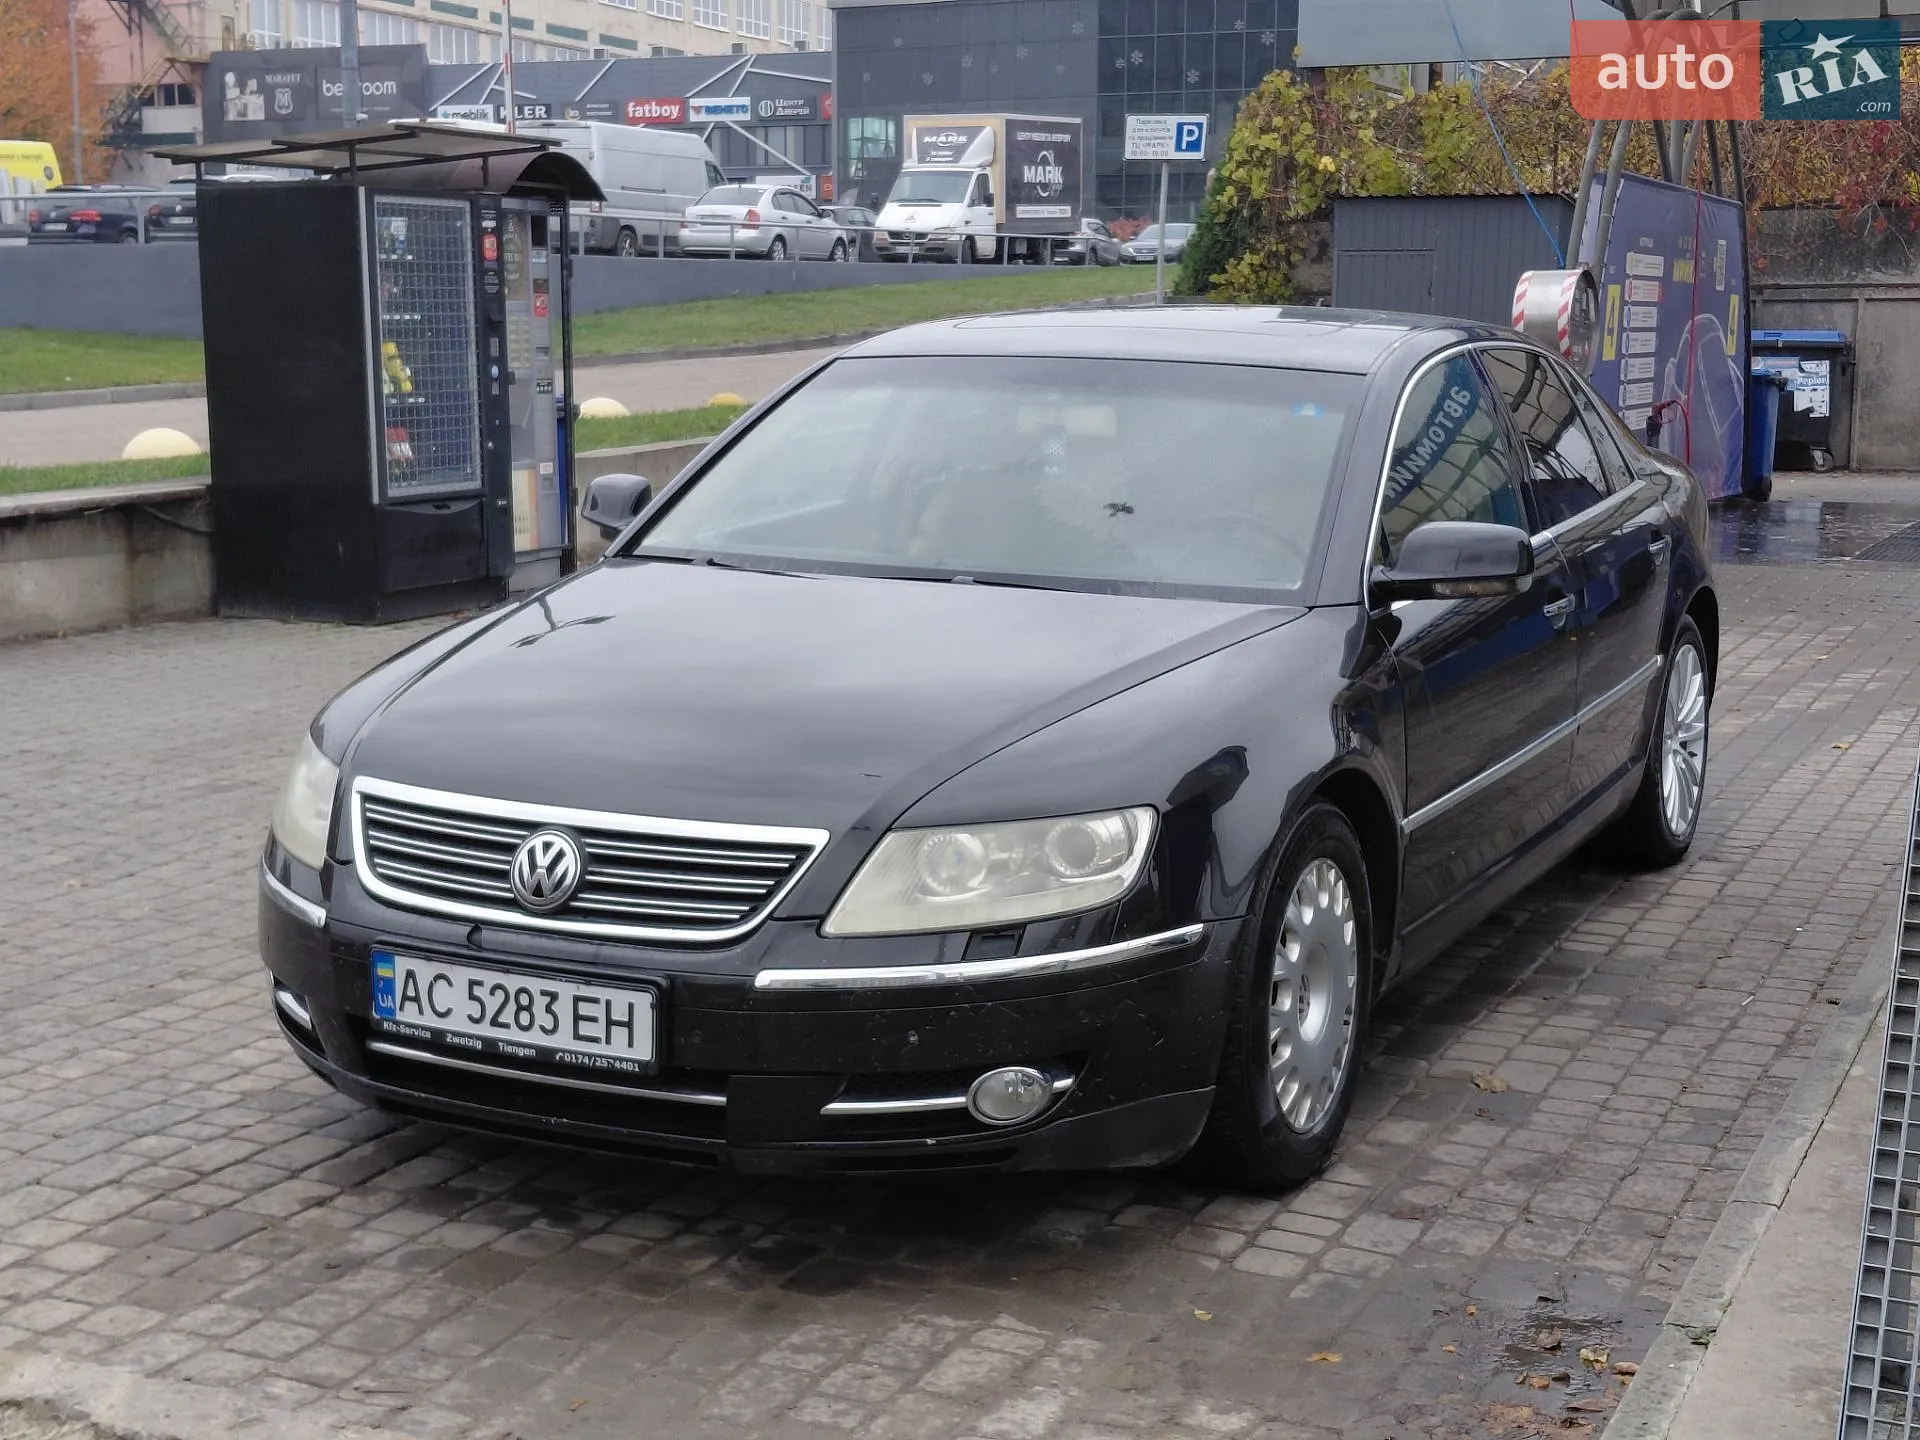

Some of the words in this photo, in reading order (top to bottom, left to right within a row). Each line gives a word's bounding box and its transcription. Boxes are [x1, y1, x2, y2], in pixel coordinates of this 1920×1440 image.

[1023, 165, 1063, 184] MARK
[377, 992, 394, 1009] UA
[399, 968, 454, 1019] AC
[466, 977, 560, 1037] 5283
[572, 993, 635, 1049] EH
